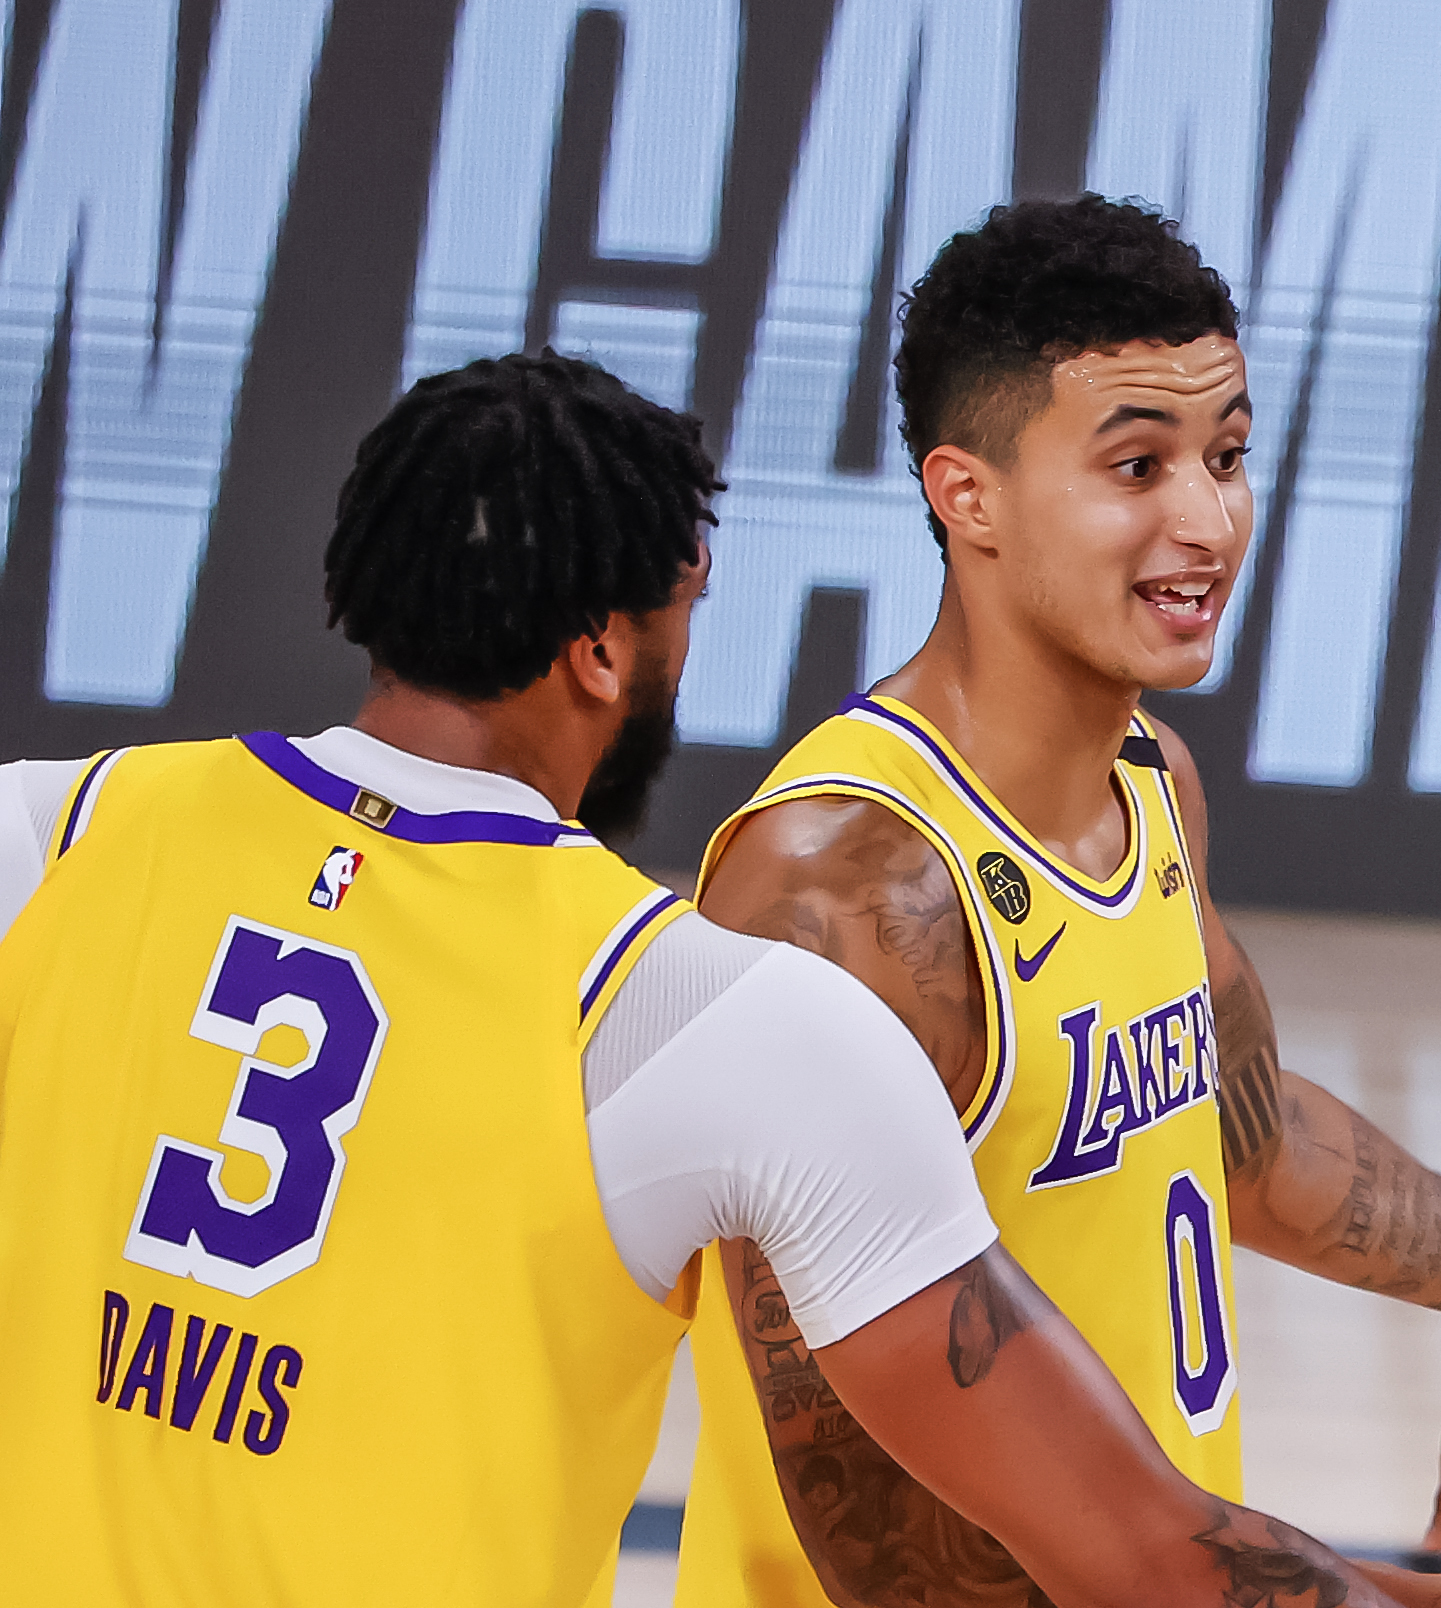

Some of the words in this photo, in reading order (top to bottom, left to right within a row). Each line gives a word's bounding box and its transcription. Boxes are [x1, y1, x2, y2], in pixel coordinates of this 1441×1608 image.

[122, 914, 390, 1299] 3
[1025, 977, 1219, 1195] LAKER
[96, 1290, 304, 1456] DAVIS
[1164, 1168, 1238, 1436] 0
